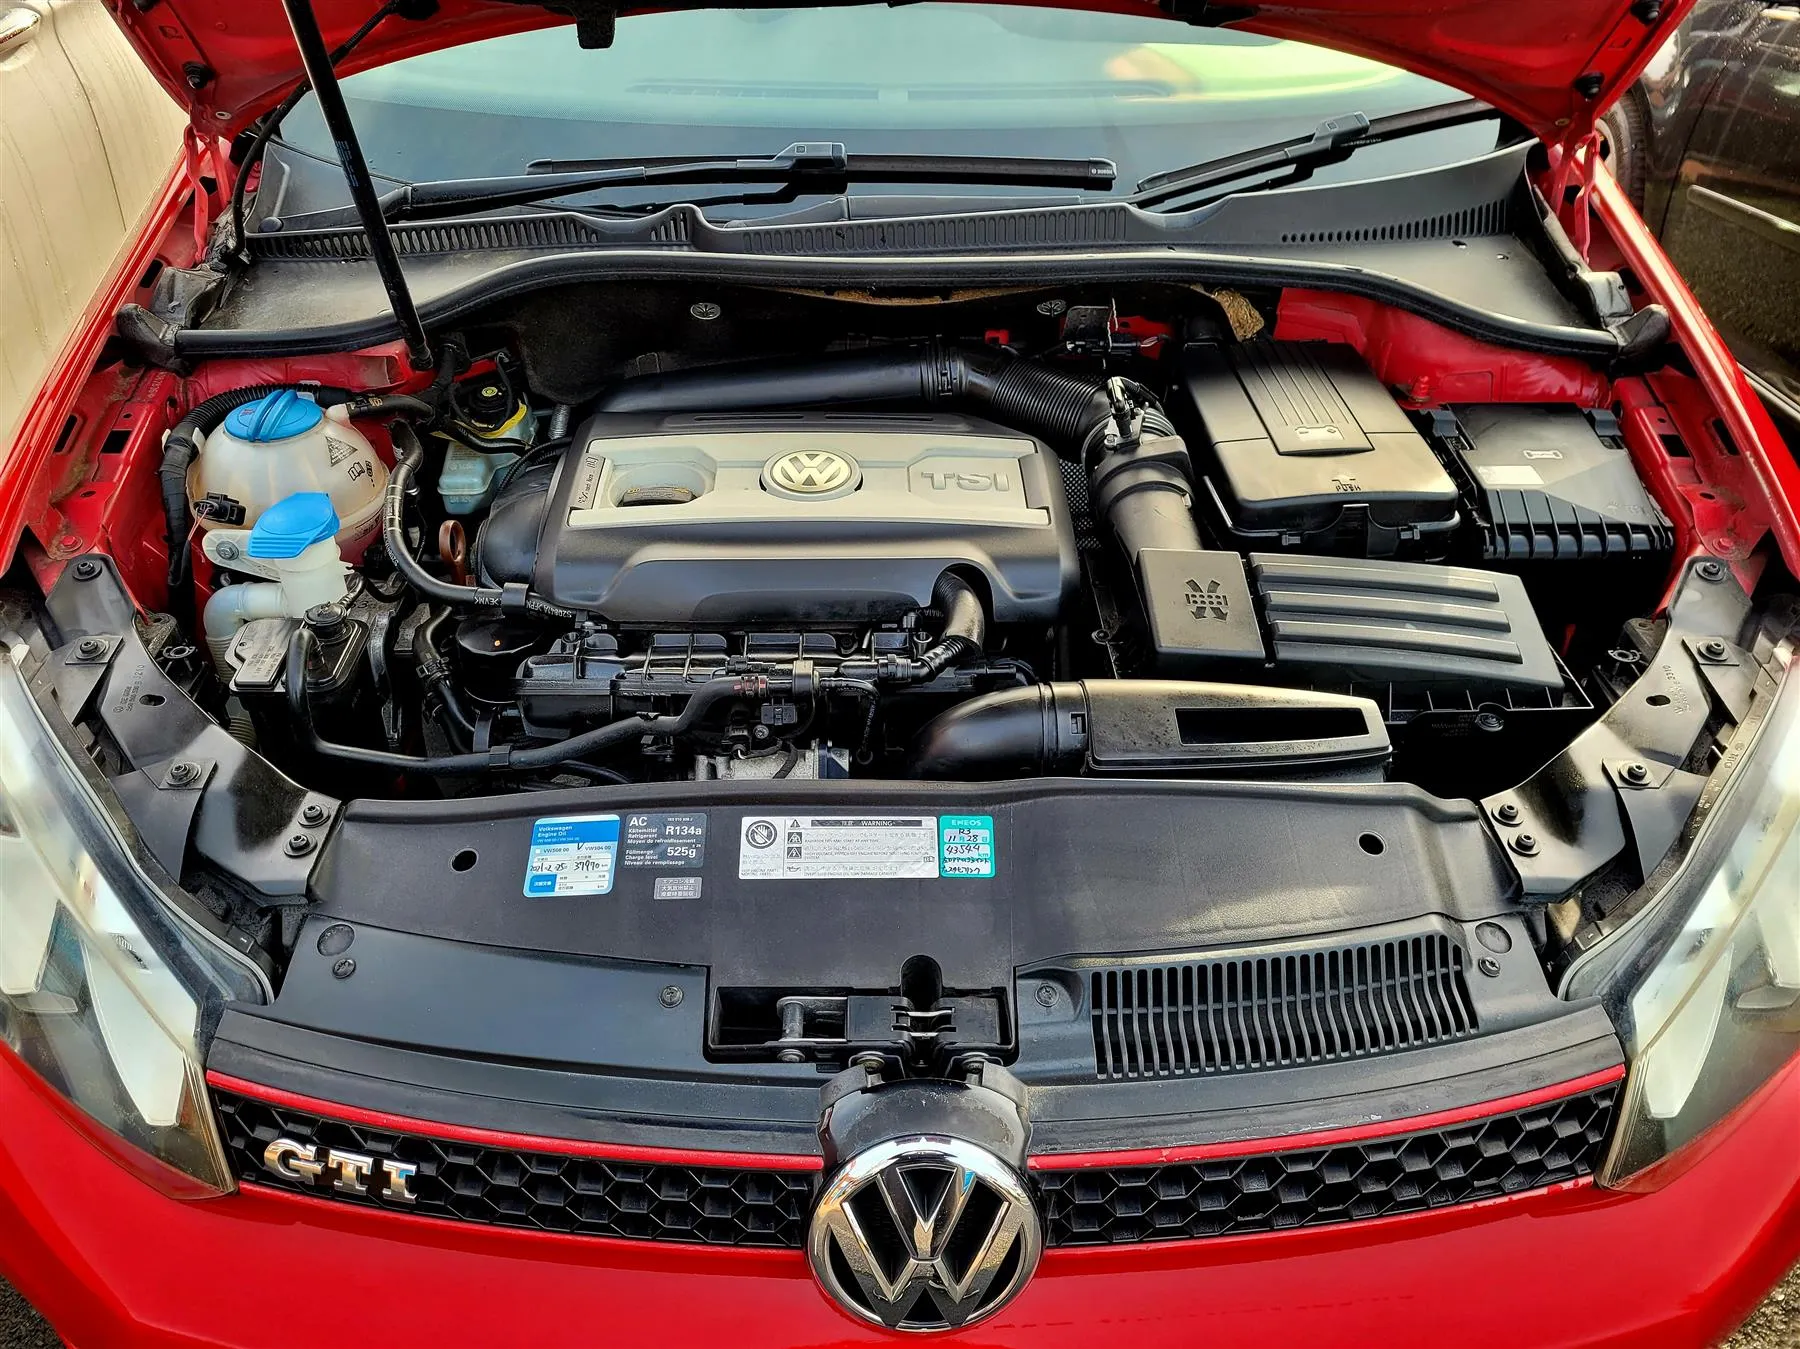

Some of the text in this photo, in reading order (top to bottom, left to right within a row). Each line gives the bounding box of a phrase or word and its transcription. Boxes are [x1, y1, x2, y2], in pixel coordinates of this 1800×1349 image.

[921, 472, 1010, 492] TSI
[629, 816, 648, 827] AC
[665, 826, 702, 836] R134a
[667, 847, 696, 858] 525g
[263, 1138, 418, 1203] GTI
[815, 1145, 1038, 1330] VW
